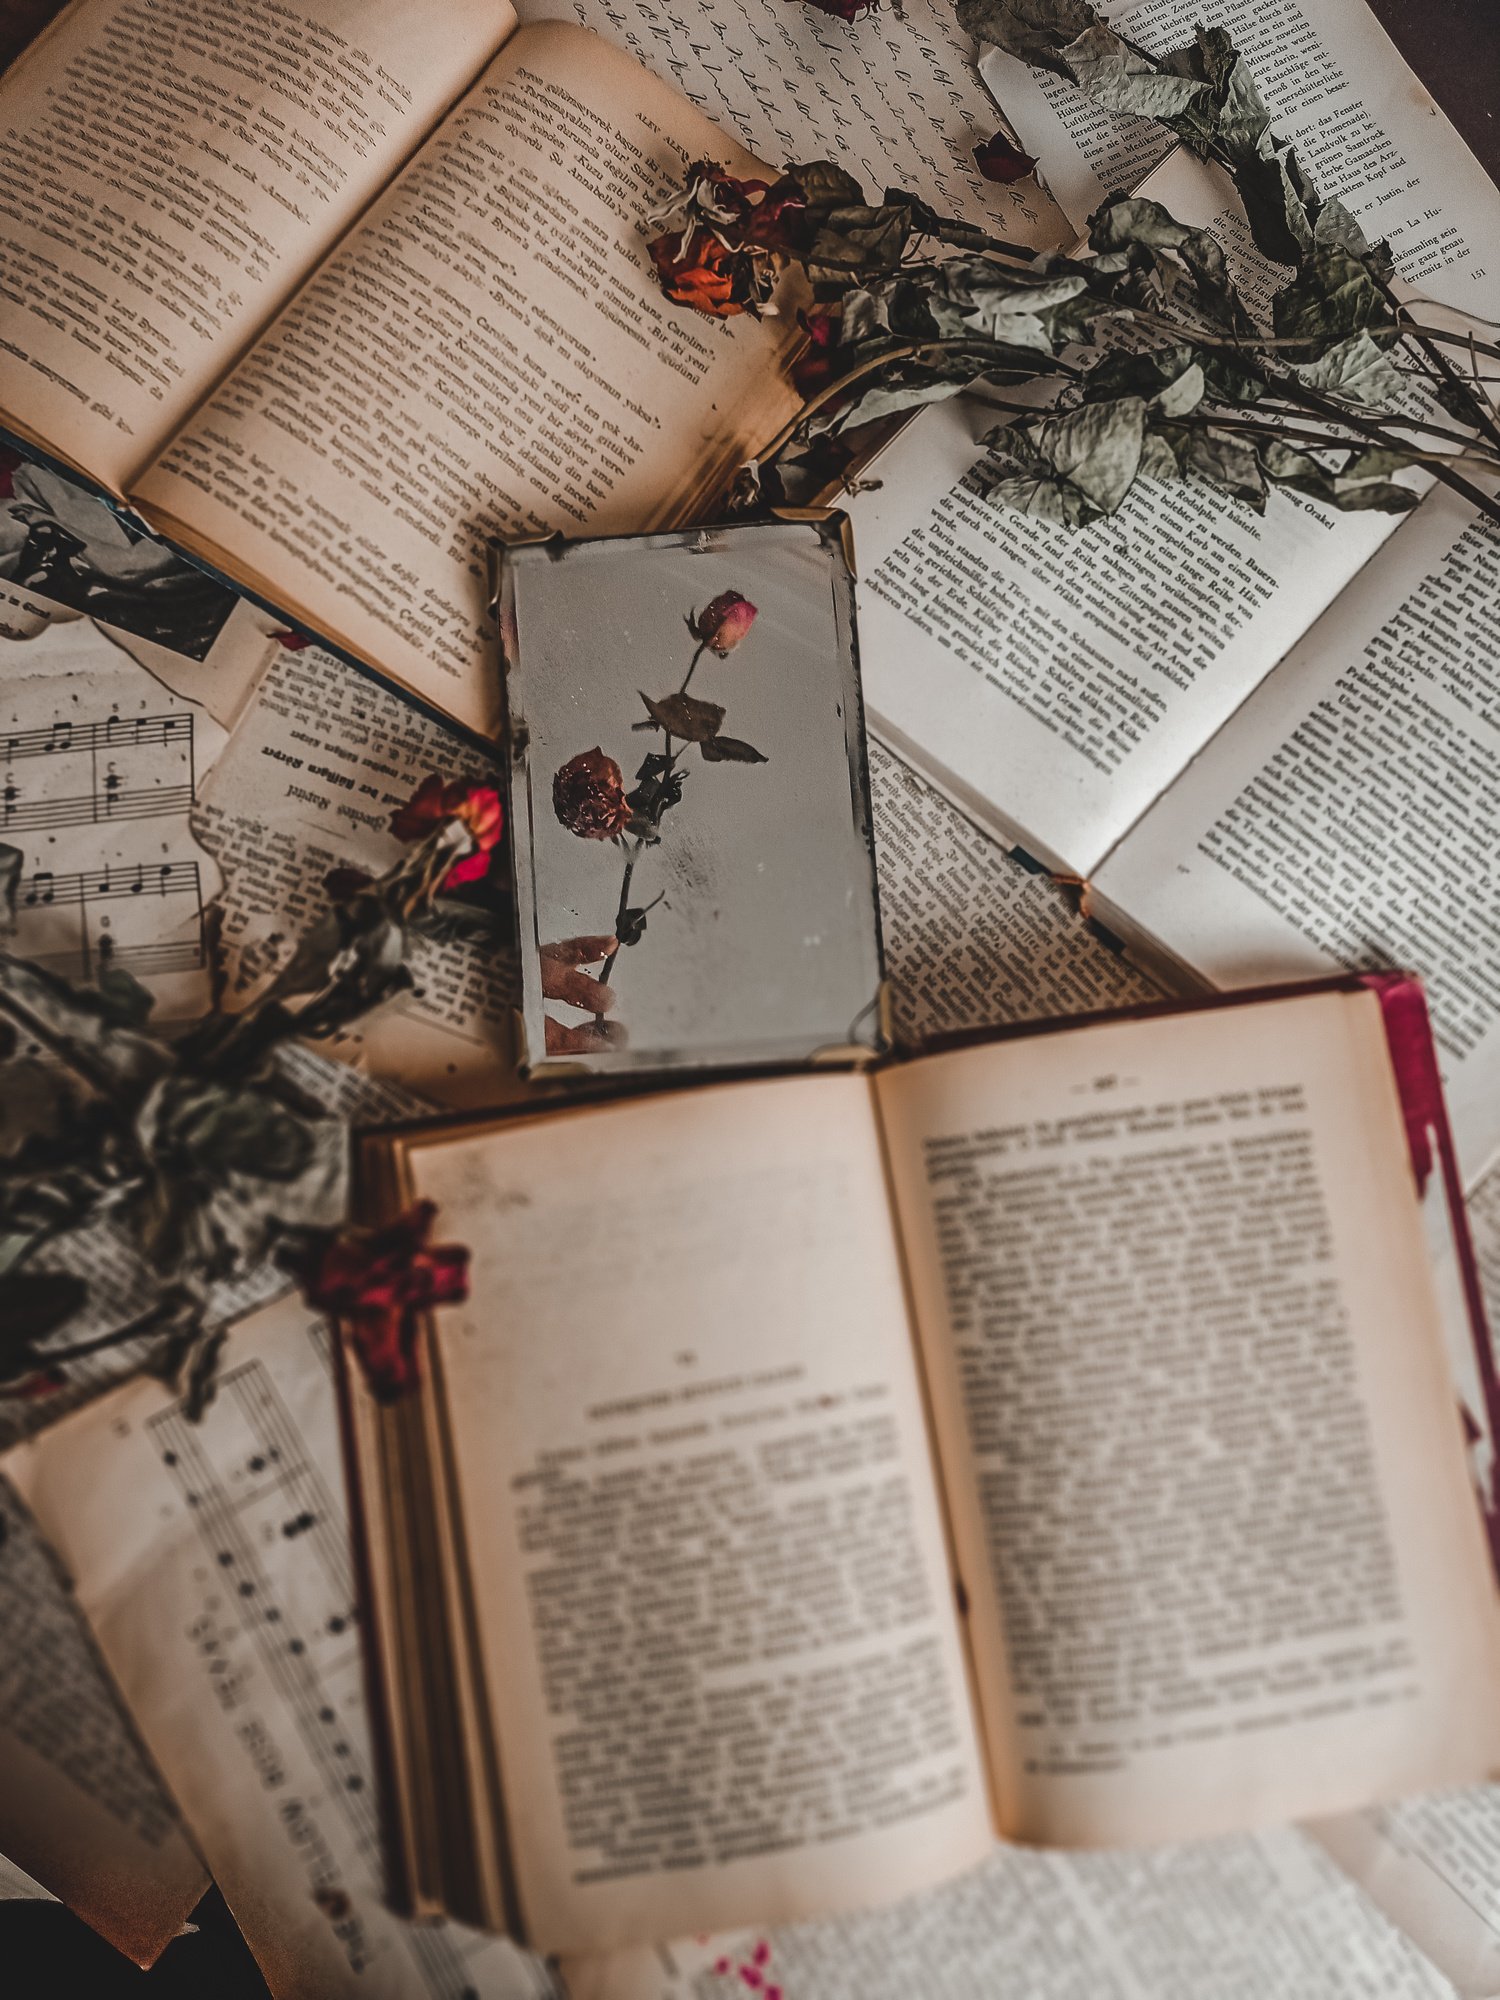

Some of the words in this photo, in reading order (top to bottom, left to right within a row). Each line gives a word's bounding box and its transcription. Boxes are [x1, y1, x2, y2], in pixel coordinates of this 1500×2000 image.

[1124, 10, 1142, 23] und
[1129, 11, 1170, 34] flatterten.
[1159, 10, 1198, 32] klebriges
[1205, 11, 1223, 23] dem
[1231, 20, 1257, 35] Hälse
[1258, 7, 1282, 23] durch
[1283, 1, 1296, 11] die
[1286, 9, 1303, 22] und
[1242, 38, 1273, 56] drückte
[1274, 21, 1310, 41] zuweilen
[1244, 43, 1288, 68] Mittwochs
[1290, 30, 1317, 46] wurde
[1273, 52, 1298, 68] darin,
[1299, 41, 1323, 54] weni-
[1038, 77, 1055, 89] und
[1262, 81, 1288, 101] genoß
[1303, 67, 1320, 79] den
[1264, 59, 1310, 85] Ratschläge
[1312, 50, 1329, 61] ent-
[1042, 85, 1068, 100] lagen
[1049, 92, 1081, 110] breitet;
[1275, 69, 1344, 106] unerschütterliche
[1283, 104, 1298, 115] für
[1301, 93, 1323, 107] einen
[1324, 80, 1350, 95] besse-
[1055, 101, 1088, 120] Hühner
[1295, 123, 1316, 138] dort:
[1317, 115, 1332, 126] das
[1332, 99, 1363, 118] Fenster
[555, 122, 600, 159] durumda
[1070, 118, 1109, 139] derselben
[1075, 137, 1093, 149] fast
[1095, 130, 1110, 141] die
[1111, 112, 1147, 133] Schaufe
[1082, 145, 1104, 159] diese
[1105, 139, 1120, 149] nie
[1120, 129, 1141, 143] leer;
[1302, 136, 1317, 147] die
[1318, 109, 1371, 139] Promenade),
[1306, 133, 1348, 158] Landvolk
[1314, 151, 1344, 170] grünen
[1344, 128, 1385, 152] Samtrock
[1320, 163, 1344, 179] derbe
[1344, 139, 1392, 166] Gamaschen
[1089, 159, 1104, 171] ger
[1096, 146, 1161, 181] gegenzunehmen,
[1323, 179, 1338, 191] das
[1337, 168, 1361, 183] Haus
[1362, 159, 1377, 170] des
[1379, 149, 1398, 163] Arz-
[1364, 165, 1387, 183] Kopf
[1388, 156, 1406, 170] und
[1375, 186, 1405, 206] Justin,
[1406, 177, 1420, 188] der
[581, 217, 609, 242] sonra
[633, 220, 650, 237] bir
[1386, 227, 1404, 238] von
[1406, 218, 1420, 228] La
[1423, 207, 1442, 219] Hu-
[576, 250, 607, 276] yapar
[1388, 235, 1439, 266] nkömmling
[1439, 227, 1457, 239] sein
[1399, 261, 1415, 273] nur
[1417, 250, 1438, 265] ganz
[1439, 237, 1464, 255] genau
[1456, 247, 1470, 258] der
[550, 246, 600, 290] Annabella
[1233, 273, 1249, 287] der
[1256, 273, 1272, 286] der
[1471, 269, 1486, 281] 151
[573, 359, 622, 401] oluyorsun
[930, 507, 957, 532] wurde.
[948, 485, 992, 522] Landwirte
[955, 509, 981, 531] durch
[1174, 489, 1217, 525] Rodolphe.
[1207, 497, 1227, 513] und
[1225, 510, 1261, 541] hüstelte.
[1303, 502, 1335, 530] Orakel
[928, 522, 955, 547] Darin
[992, 520, 1019, 545] traten,
[1020, 542, 1043, 561] einer
[1008, 514, 1040, 542] Gerade
[1040, 539, 1064, 560] fand
[1034, 518, 1051, 534] von
[1071, 546, 1097, 570] Reihe
[1159, 494, 1195, 523] belebter
[1209, 532, 1242, 560] werden.
[927, 540, 988, 589] ungleichmäßig
[955, 544, 989, 572] standen
[1121, 502, 1149, 526] Arme,
[1151, 523, 1195, 558] rempelten
[1196, 556, 1220, 577] einen
[1237, 586, 1261, 608] Häu-
[1131, 525, 1155, 546] wenn
[1157, 545, 1177, 561] eine
[1179, 559, 1205, 582] lange
[1207, 579, 1234, 603] Reihe
[1159, 512, 1183, 532] einen
[1184, 529, 1209, 550] Korb
[1227, 563, 1251, 583] einen
[1253, 583, 1273, 599] und
[965, 584, 1009, 622] Schläfrige
[1101, 553, 1136, 582] nahmen
[1159, 598, 1192, 624] ganzen
[1143, 549, 1173, 576] blauen
[1173, 572, 1221, 613] Strümpfen,
[1224, 610, 1243, 628] der-
